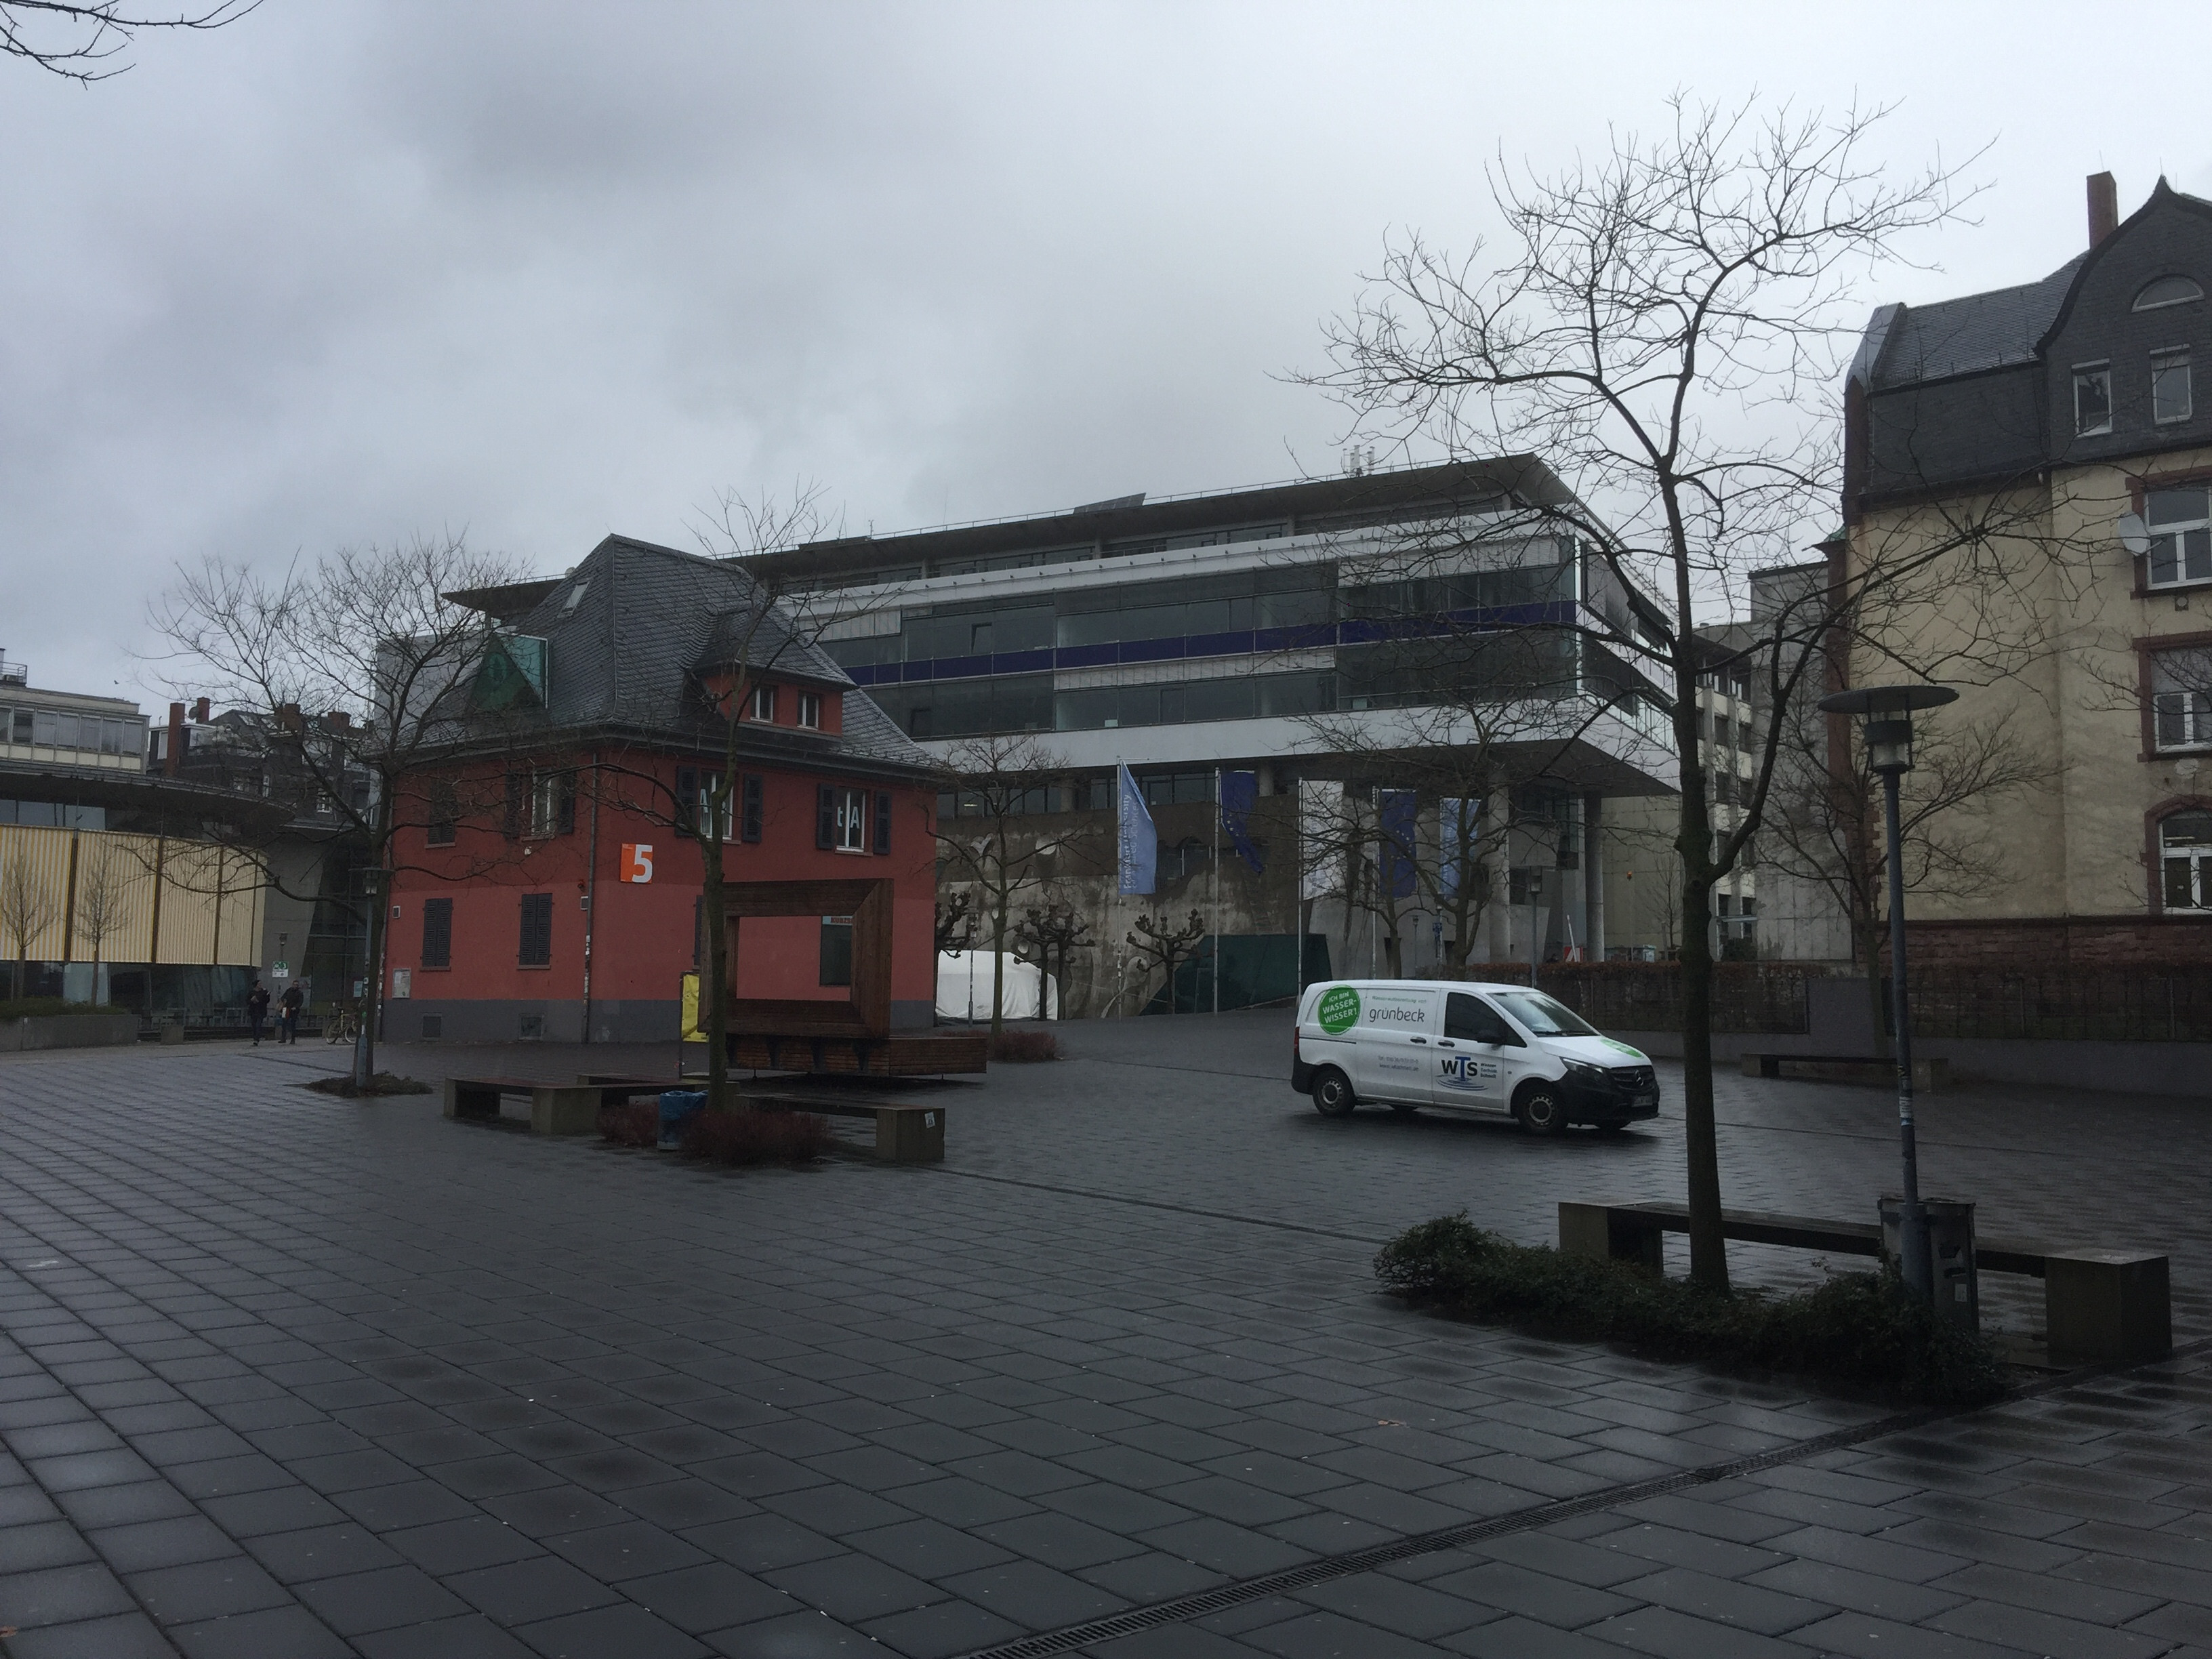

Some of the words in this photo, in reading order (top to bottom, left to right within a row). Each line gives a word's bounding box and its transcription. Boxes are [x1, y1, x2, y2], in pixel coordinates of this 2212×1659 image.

[632, 844, 653, 882] 5
[1339, 991, 1349, 1000] BIN
[1322, 998, 1357, 1014] WASSER-
[1370, 1006, 1425, 1023] grünbeck
[1441, 1056, 1477, 1082] WTS
